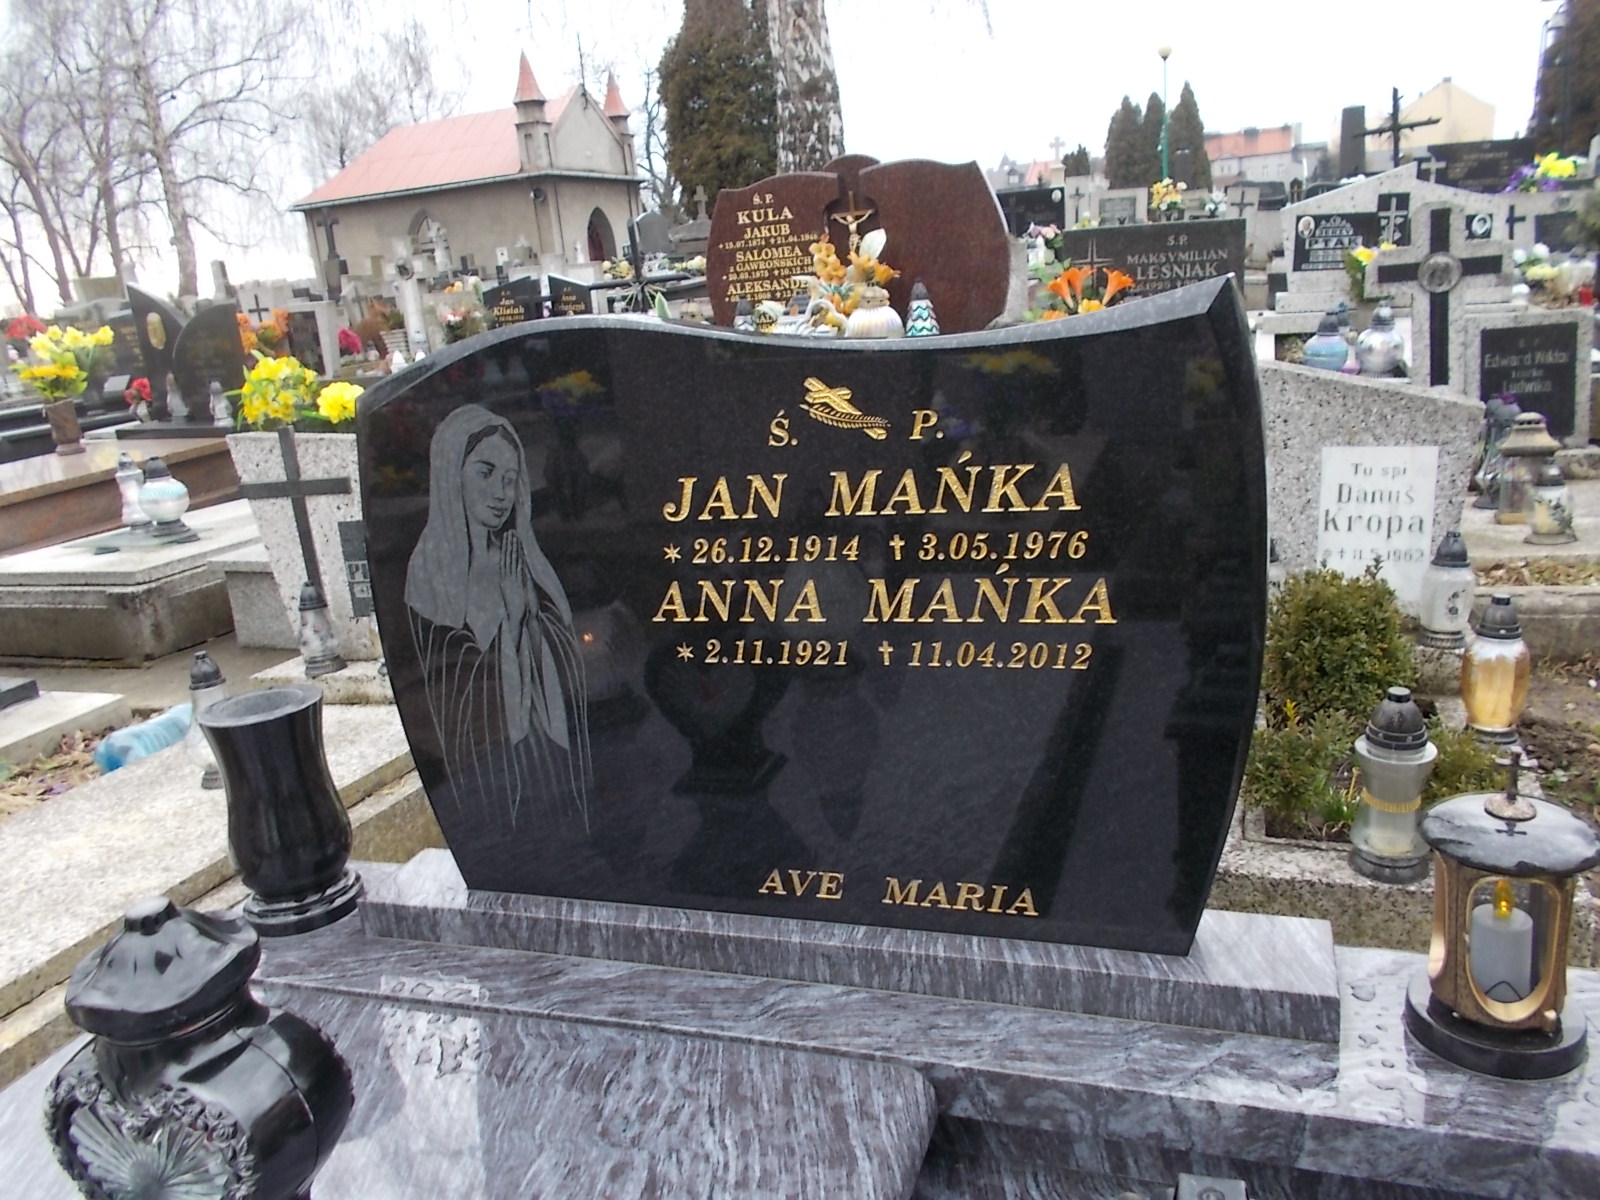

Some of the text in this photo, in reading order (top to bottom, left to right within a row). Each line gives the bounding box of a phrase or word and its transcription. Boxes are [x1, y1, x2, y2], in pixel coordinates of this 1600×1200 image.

[736, 206, 794, 225] KULA
[744, 223, 791, 239] JAKUB
[1306, 236, 1362, 250] PTAK
[736, 245, 802, 262] SALOMEA
[1127, 249, 1229, 265] MAKSYMILIAN
[768, 409, 944, 447] Ś. P.
[1352, 462, 1373, 475] Tu
[663, 450, 1082, 522] JAN MAŃKA
[692, 531, 1088, 564] 26.12.1914 3.05.1976
[652, 563, 1117, 625] ANNA MAŃKA
[704, 639, 1093, 670] 2.11.1921 11.04.2012
[758, 868, 1039, 916] AVE MARIA
